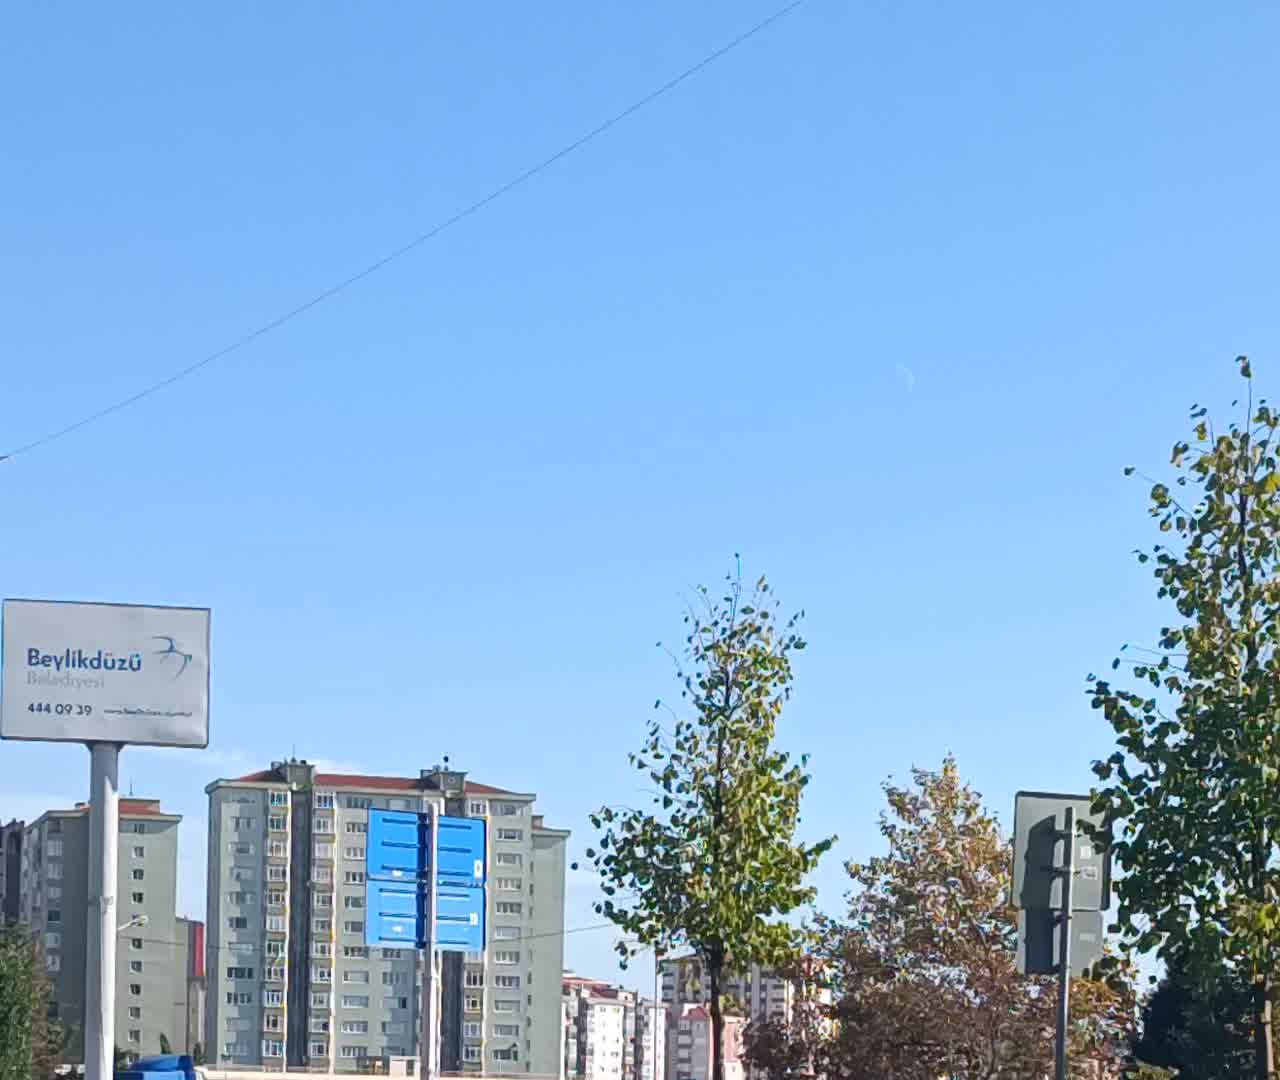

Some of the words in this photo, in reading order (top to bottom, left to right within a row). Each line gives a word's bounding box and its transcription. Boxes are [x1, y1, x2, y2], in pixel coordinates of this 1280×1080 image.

[27, 647, 142, 672] Beylikdüzü
[27, 702, 52, 714] 444
[55, 703, 73, 716] 09
